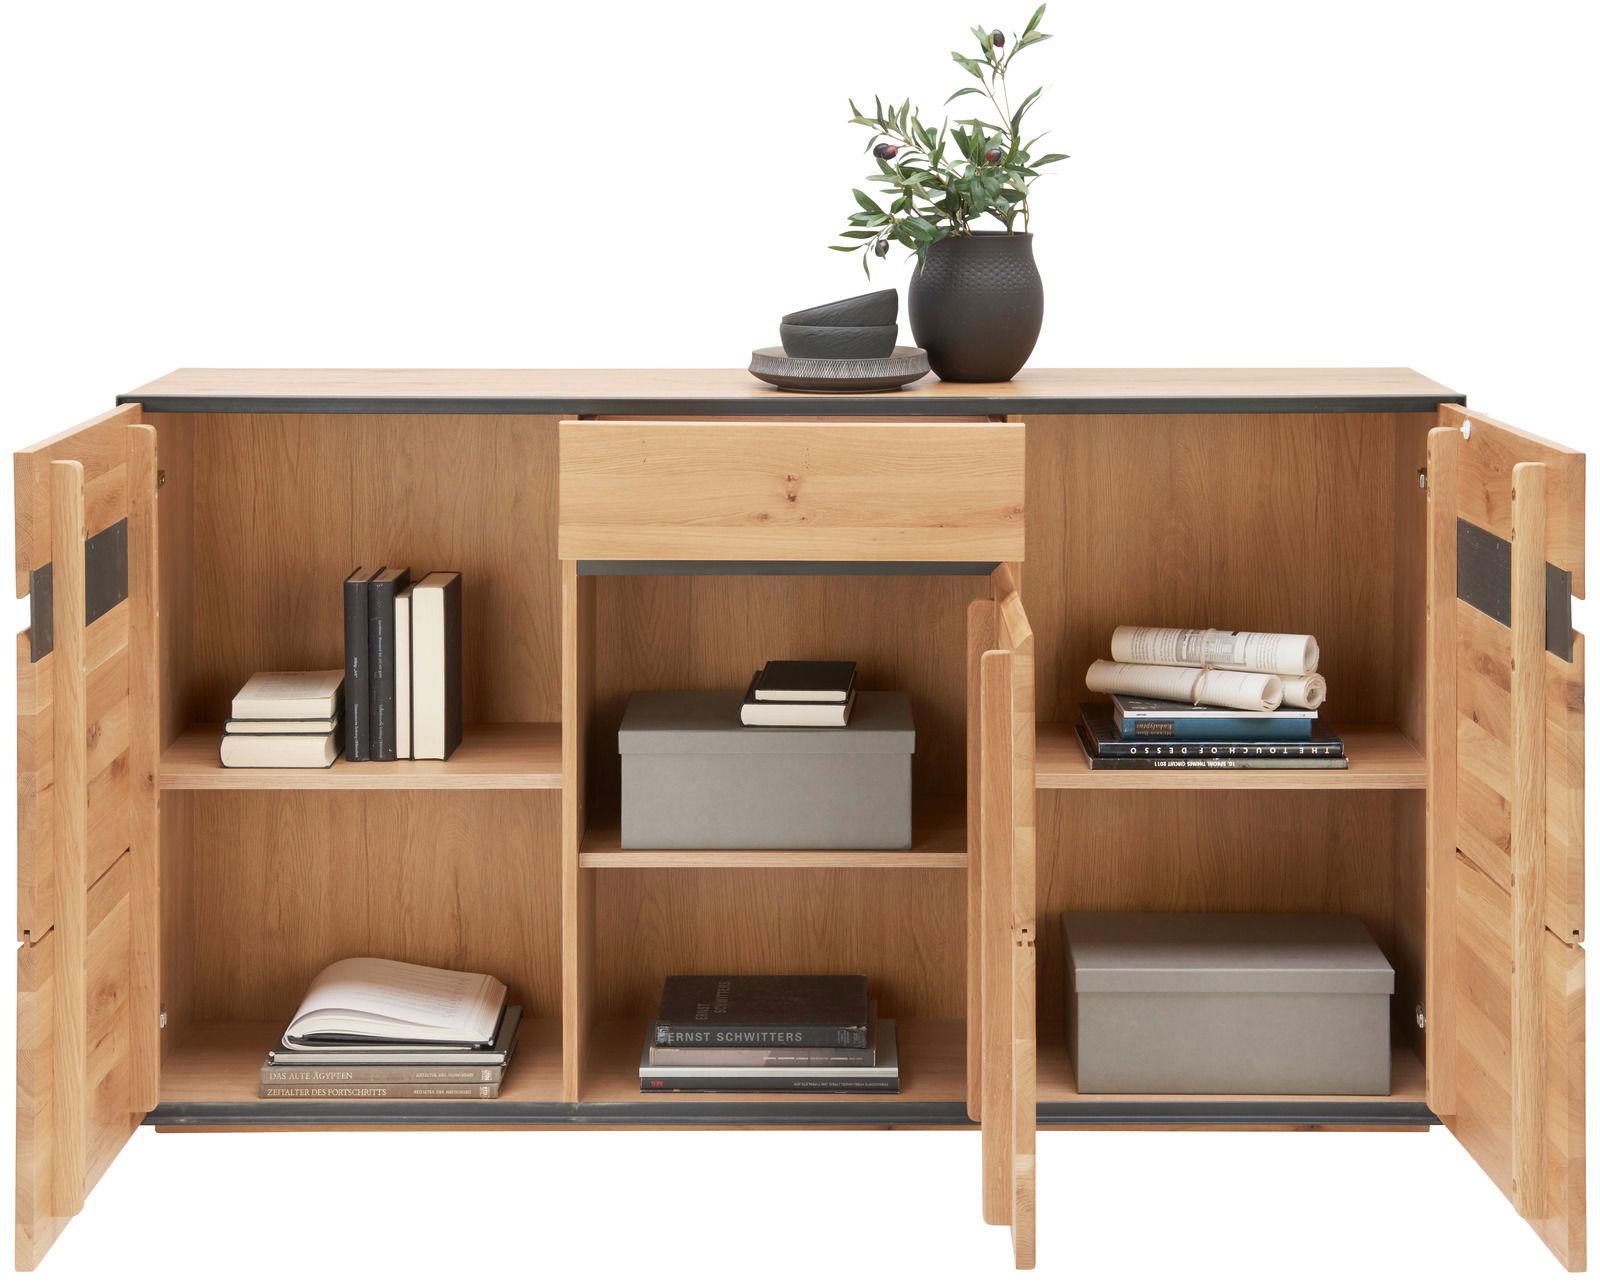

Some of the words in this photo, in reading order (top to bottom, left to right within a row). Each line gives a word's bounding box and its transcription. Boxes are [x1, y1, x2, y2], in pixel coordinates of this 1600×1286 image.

[1130, 746, 1188, 755] DESSO
[1198, 746, 1218, 755] OF
[1229, 746, 1288, 755] TOUCH
[1298, 746, 1330, 755] THE
[667, 1031, 711, 1043] ERNST
[716, 1031, 803, 1043] SCHWITTERS
[269, 1071, 287, 1081] DAS
[289, 1071, 313, 1081] ALTE
[313, 1070, 353, 1081] ÄGYPTEN
[267, 1088, 310, 1097] ZEITALTER
[311, 1088, 328, 1097] DES
[328, 1088, 387, 1097] FORTSCHRITTS
